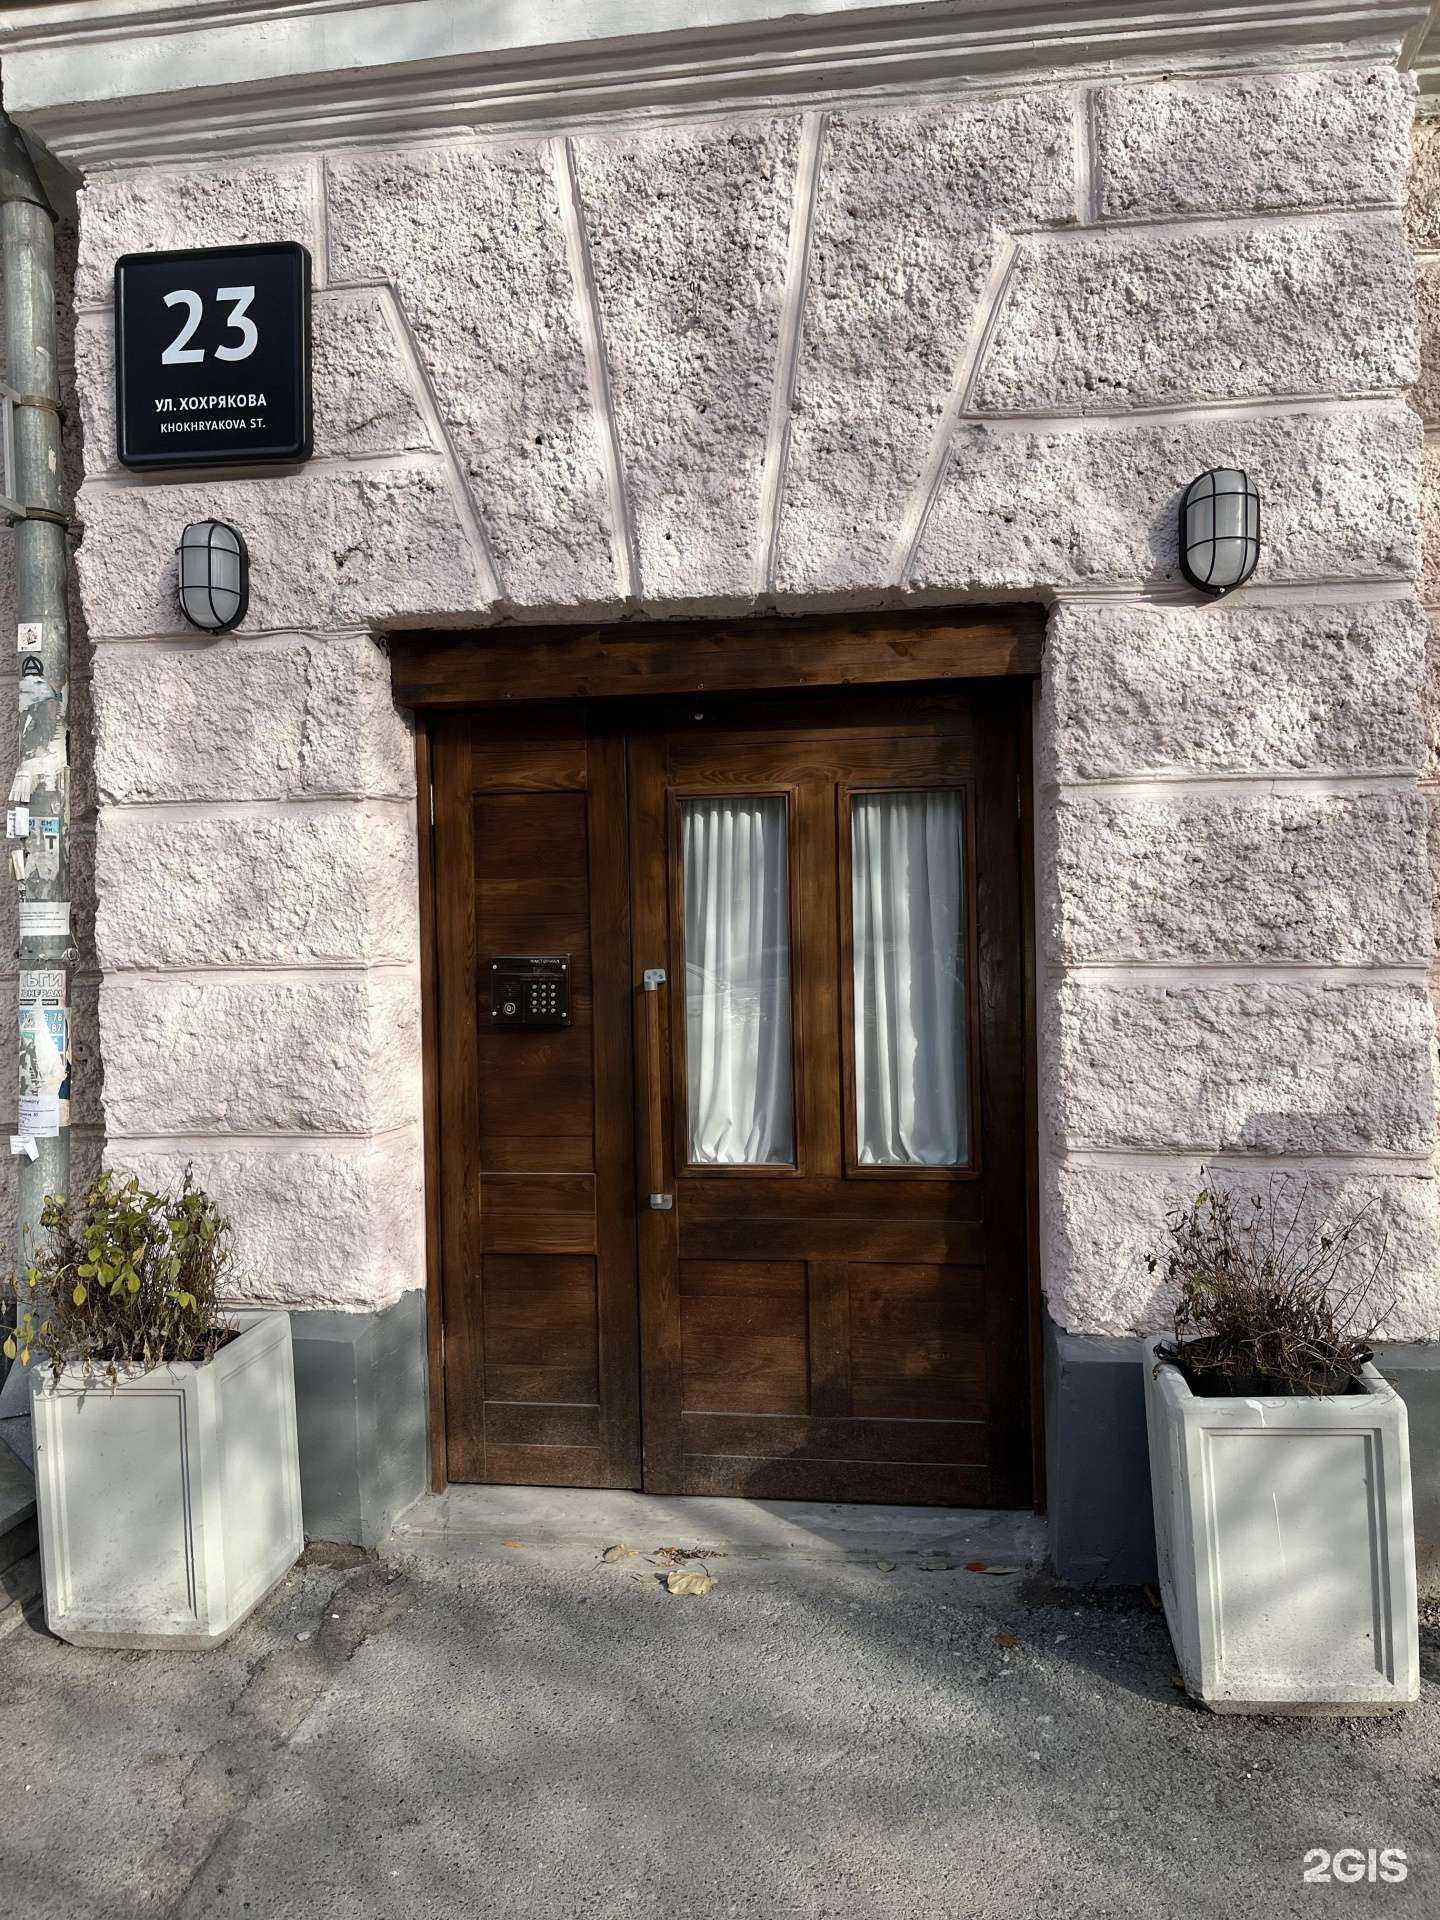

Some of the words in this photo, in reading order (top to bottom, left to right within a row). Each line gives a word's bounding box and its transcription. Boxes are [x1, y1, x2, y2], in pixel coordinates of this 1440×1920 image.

[161, 285, 259, 365] 23
[155, 398, 177, 413] УЛ.
[179, 393, 267, 411] ХОХРЯКОВА
[160, 419, 247, 434] KHOKHRYAKOVA
[250, 418, 266, 429] ST.
